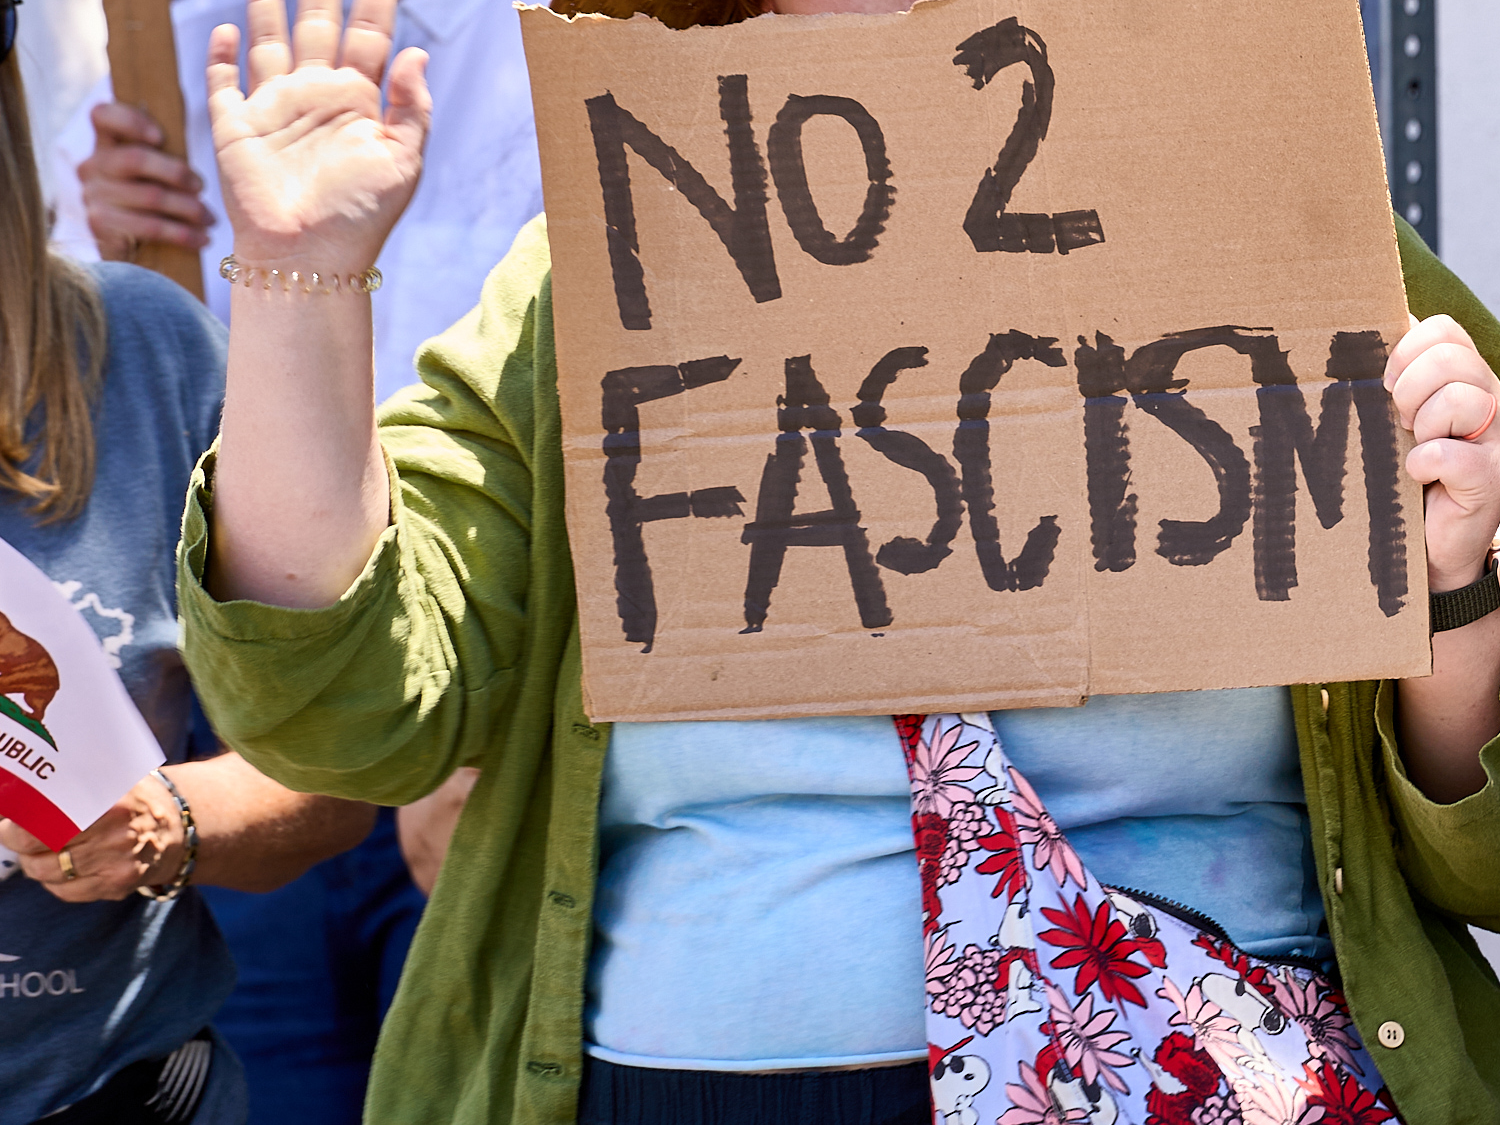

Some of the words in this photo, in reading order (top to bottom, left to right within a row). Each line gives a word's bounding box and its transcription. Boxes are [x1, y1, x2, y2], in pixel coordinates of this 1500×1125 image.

[584, 74, 898, 331] NO
[952, 16, 1106, 256] 2
[600, 325, 1408, 654] FASCISM
